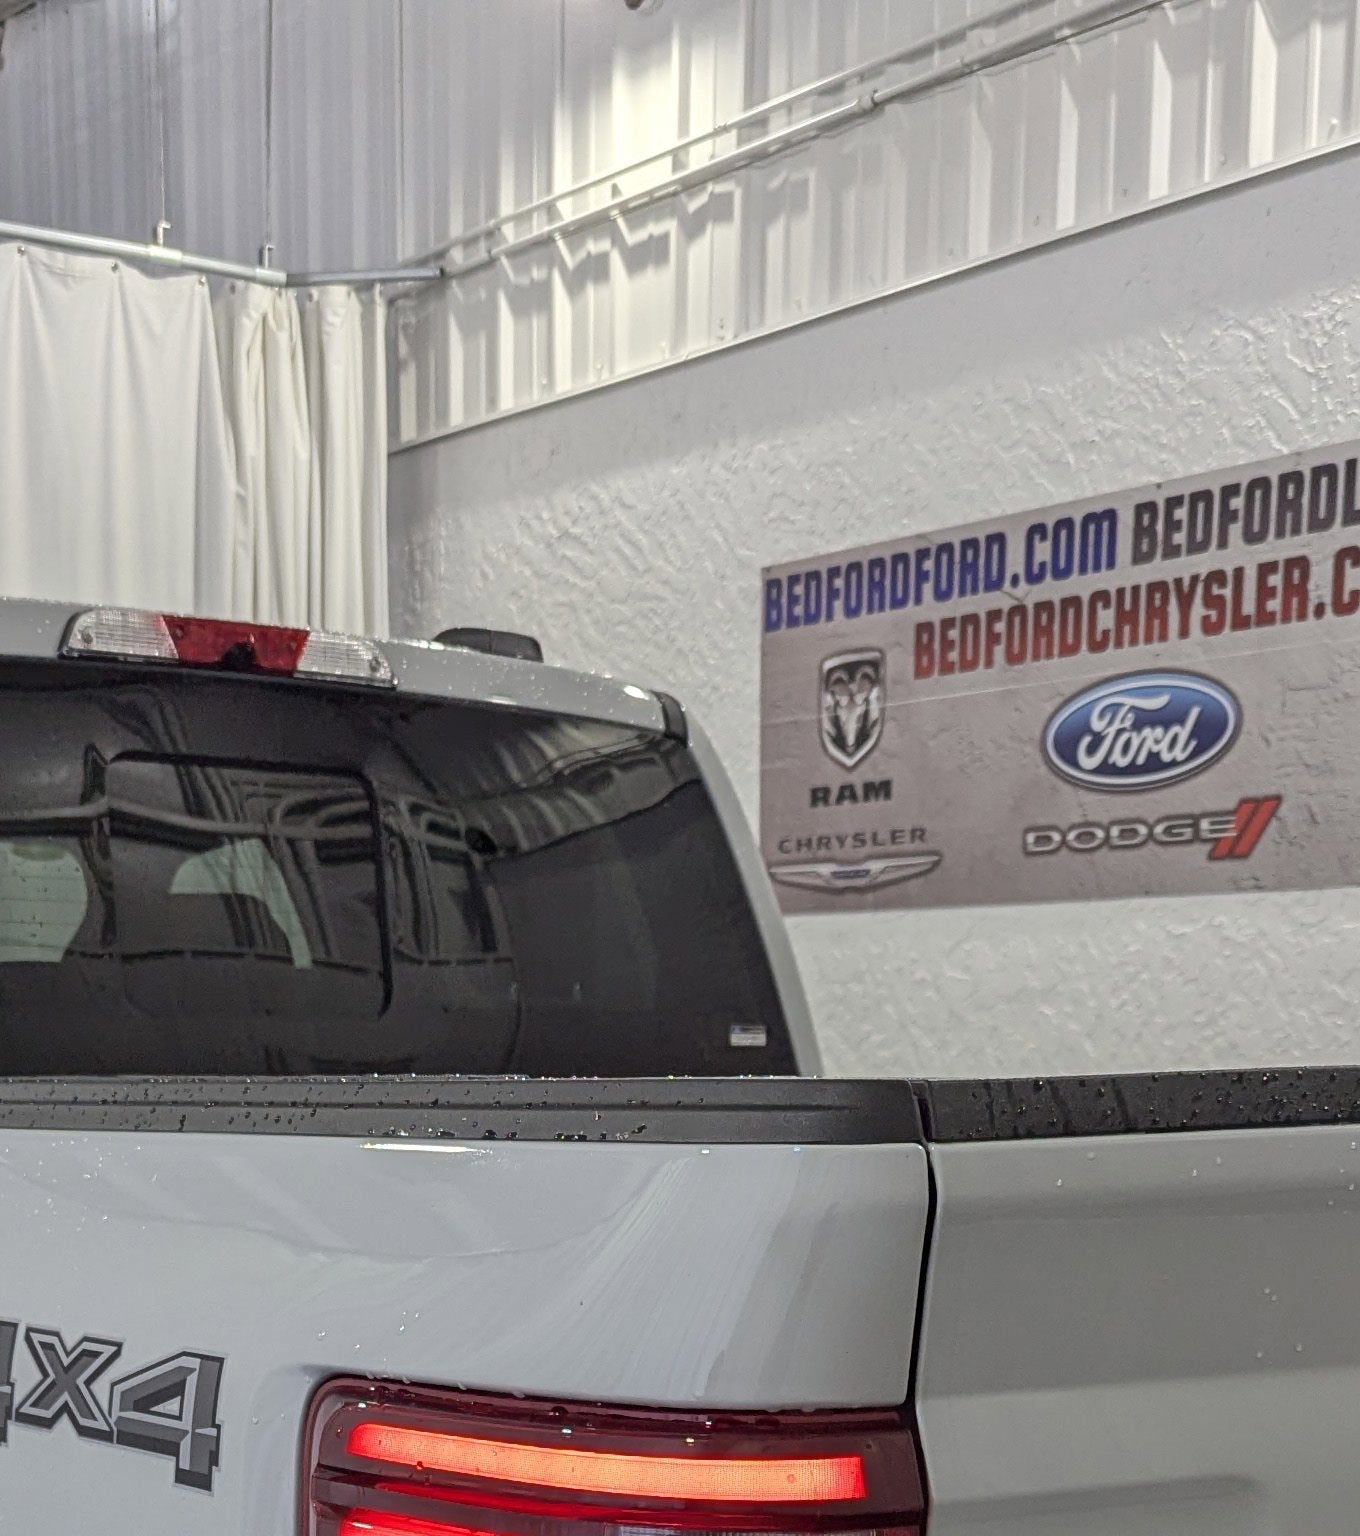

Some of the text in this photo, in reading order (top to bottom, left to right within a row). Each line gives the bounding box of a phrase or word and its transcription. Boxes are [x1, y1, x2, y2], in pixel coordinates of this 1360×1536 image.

[763, 507, 1118, 634] BEDFORDFORD.COM
[1076, 692, 1204, 771] Ford
[809, 779, 893, 808] RAM
[776, 826, 928, 856] CHRYSLER
[1024, 809, 1240, 856] DODGE
